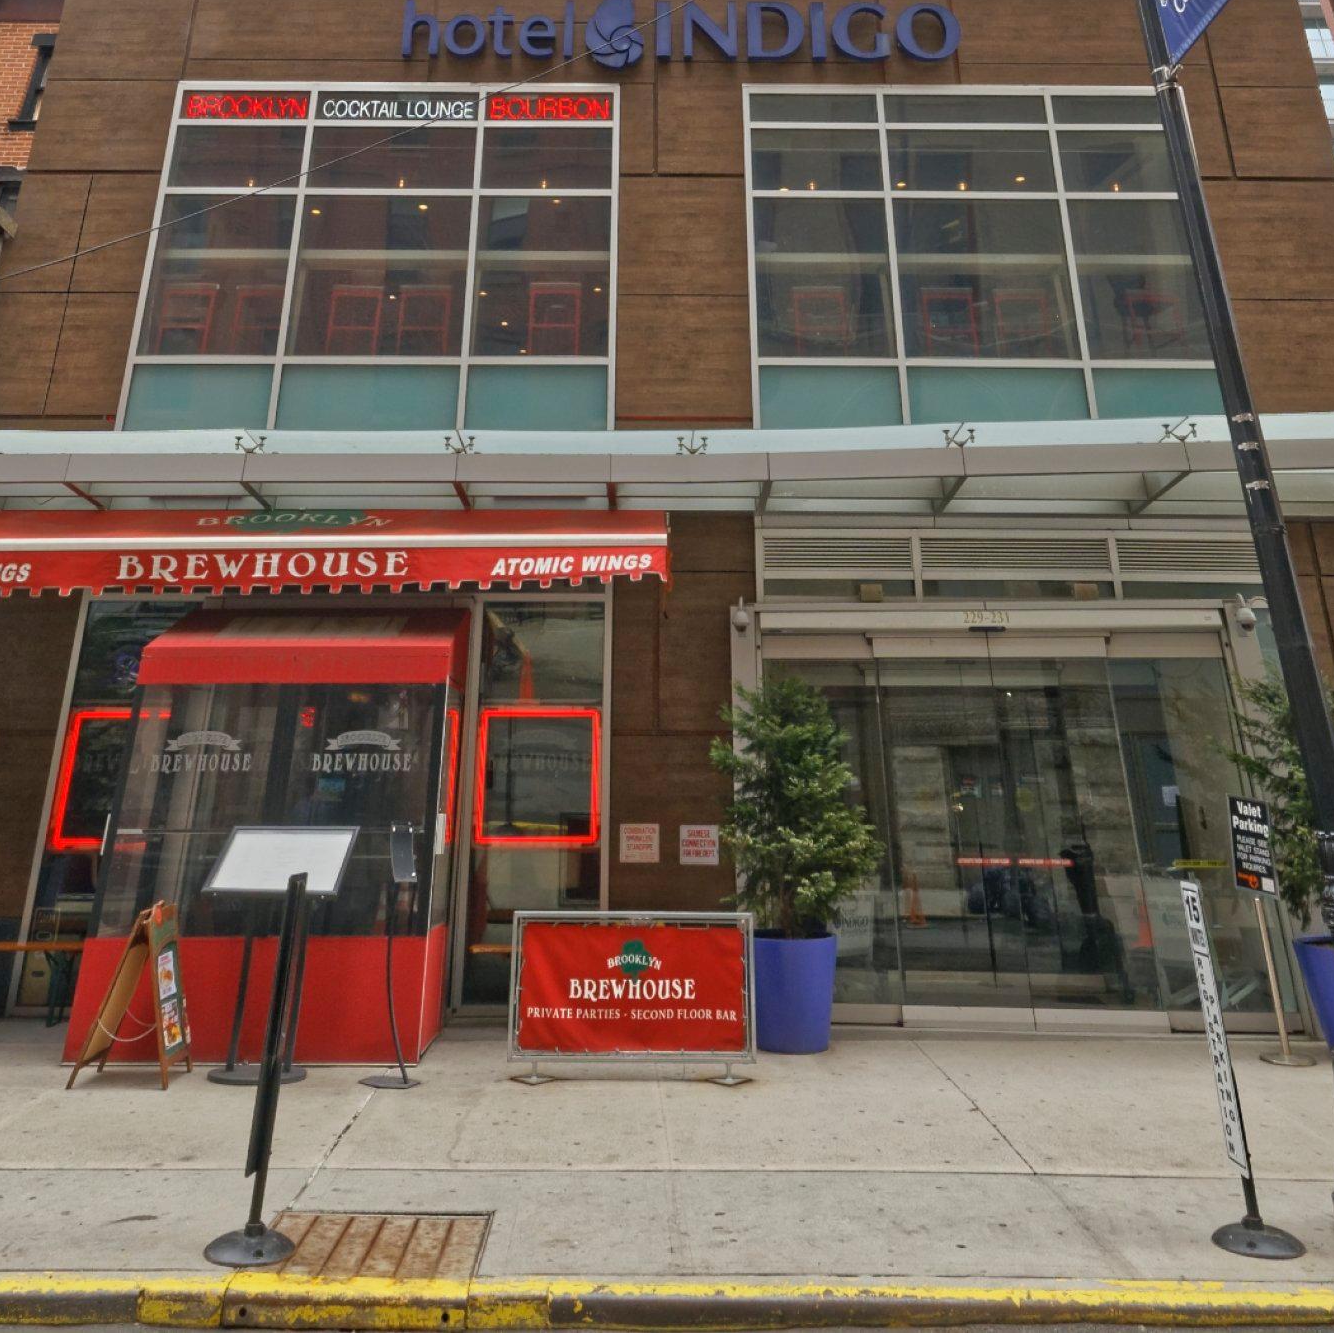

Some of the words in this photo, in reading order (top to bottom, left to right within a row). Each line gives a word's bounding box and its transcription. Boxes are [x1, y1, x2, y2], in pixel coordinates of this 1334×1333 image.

[656, 0, 962, 63] INDIGO
[186, 95, 307, 119] BROOKLYN
[322, 99, 402, 119] COCKTAIL
[406, 99, 474, 119] LOUNGE
[490, 96, 610, 120] BOURBON
[196, 509, 394, 528] BROOKLYN
[116, 550, 410, 583] BREWHOUSE
[490, 556, 574, 577] ATOMIC
[581, 553, 653, 573] WINGS
[150, 753, 252, 774] BREWHOUSE
[312, 753, 412, 773] BREWHOUSE
[1236, 800, 1262, 819] Valet
[1232, 815, 1270, 838] Parking
[1185, 895, 1200, 923] 15
[606, 953, 662, 971] BROOKLYN
[568, 978, 696, 1002] BREWHOUSE
[526, 1007, 573, 1019] PRIVATE
[576, 1007, 621, 1020] PARTIES
[630, 1008, 674, 1021] SECOND
[677, 1008, 713, 1021] FLOOR
[716, 1009, 738, 1022] BAR
